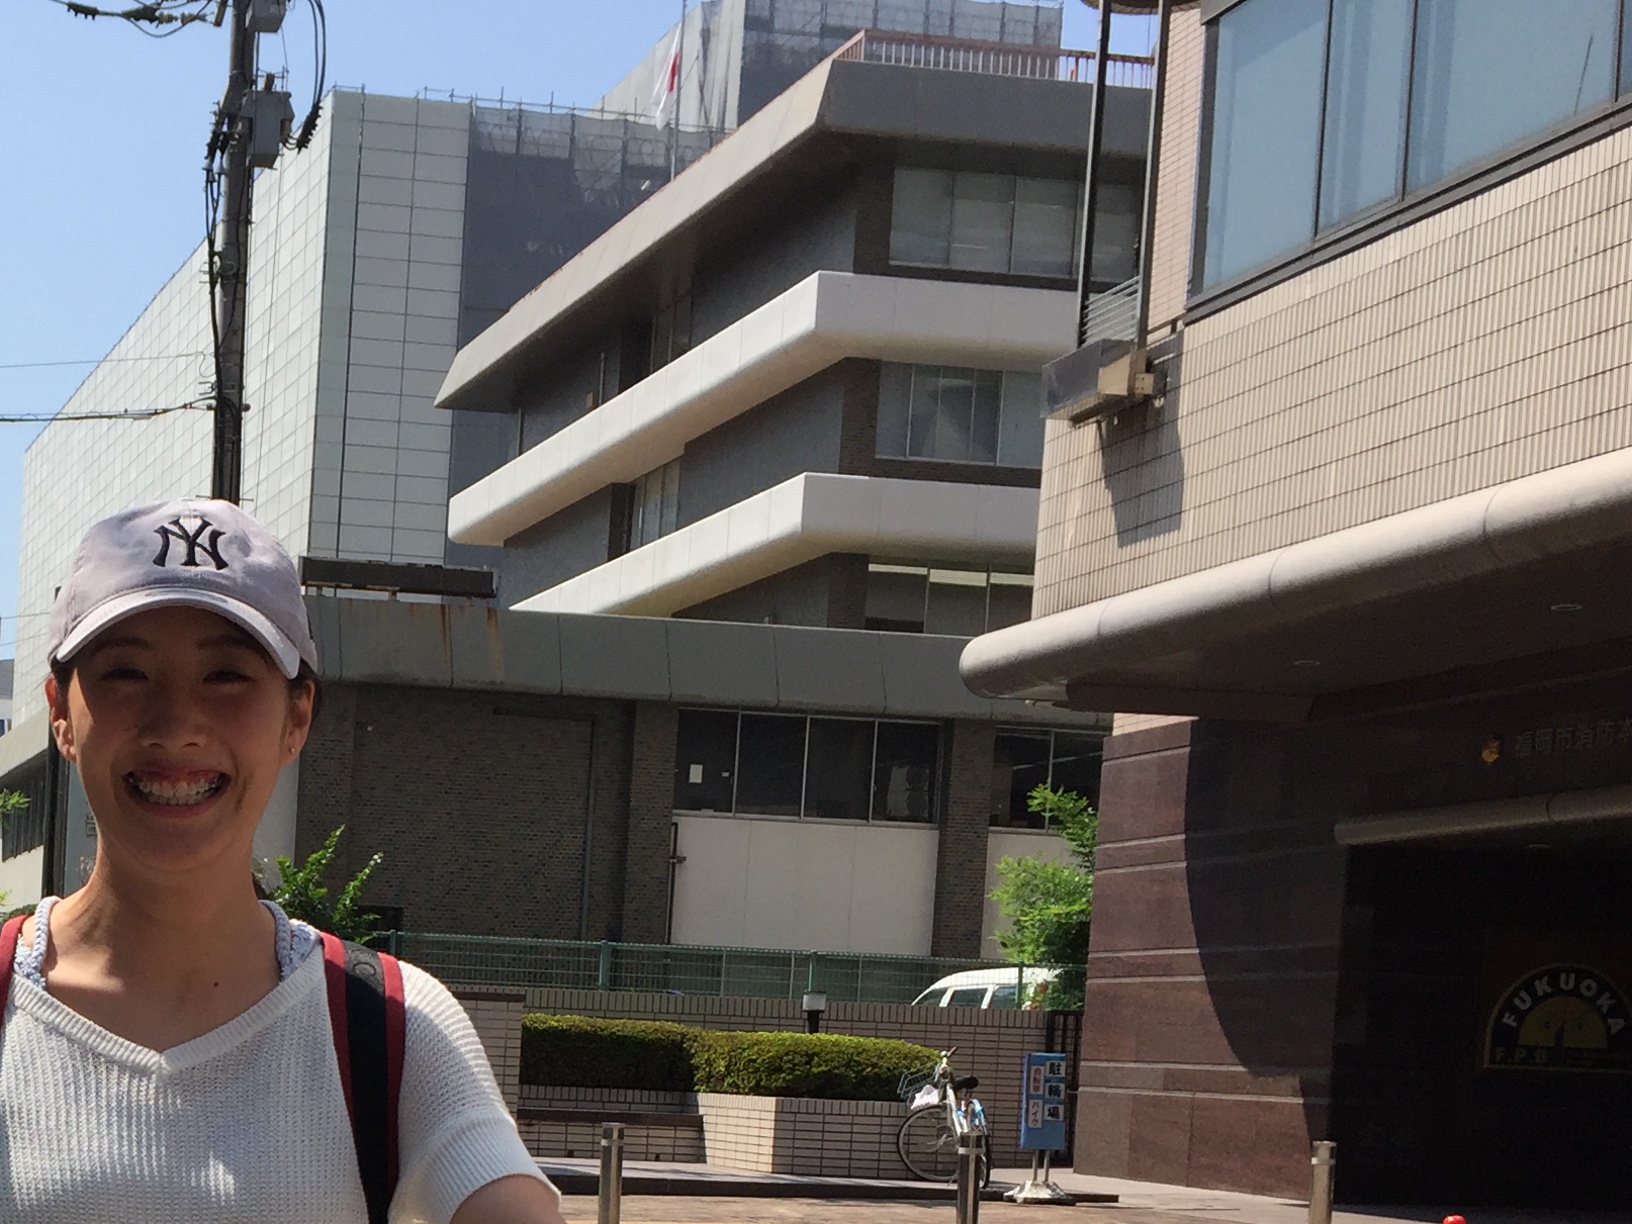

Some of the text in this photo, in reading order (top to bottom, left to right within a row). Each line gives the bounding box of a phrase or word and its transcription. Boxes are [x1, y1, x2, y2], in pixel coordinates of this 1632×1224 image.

[152, 517, 229, 570] NY
[1500, 971, 1626, 1036] FUKUOKA
[1031, 1101, 1040, 1127] バイク
[1047, 1062, 1062, 1120] 駐輪場
